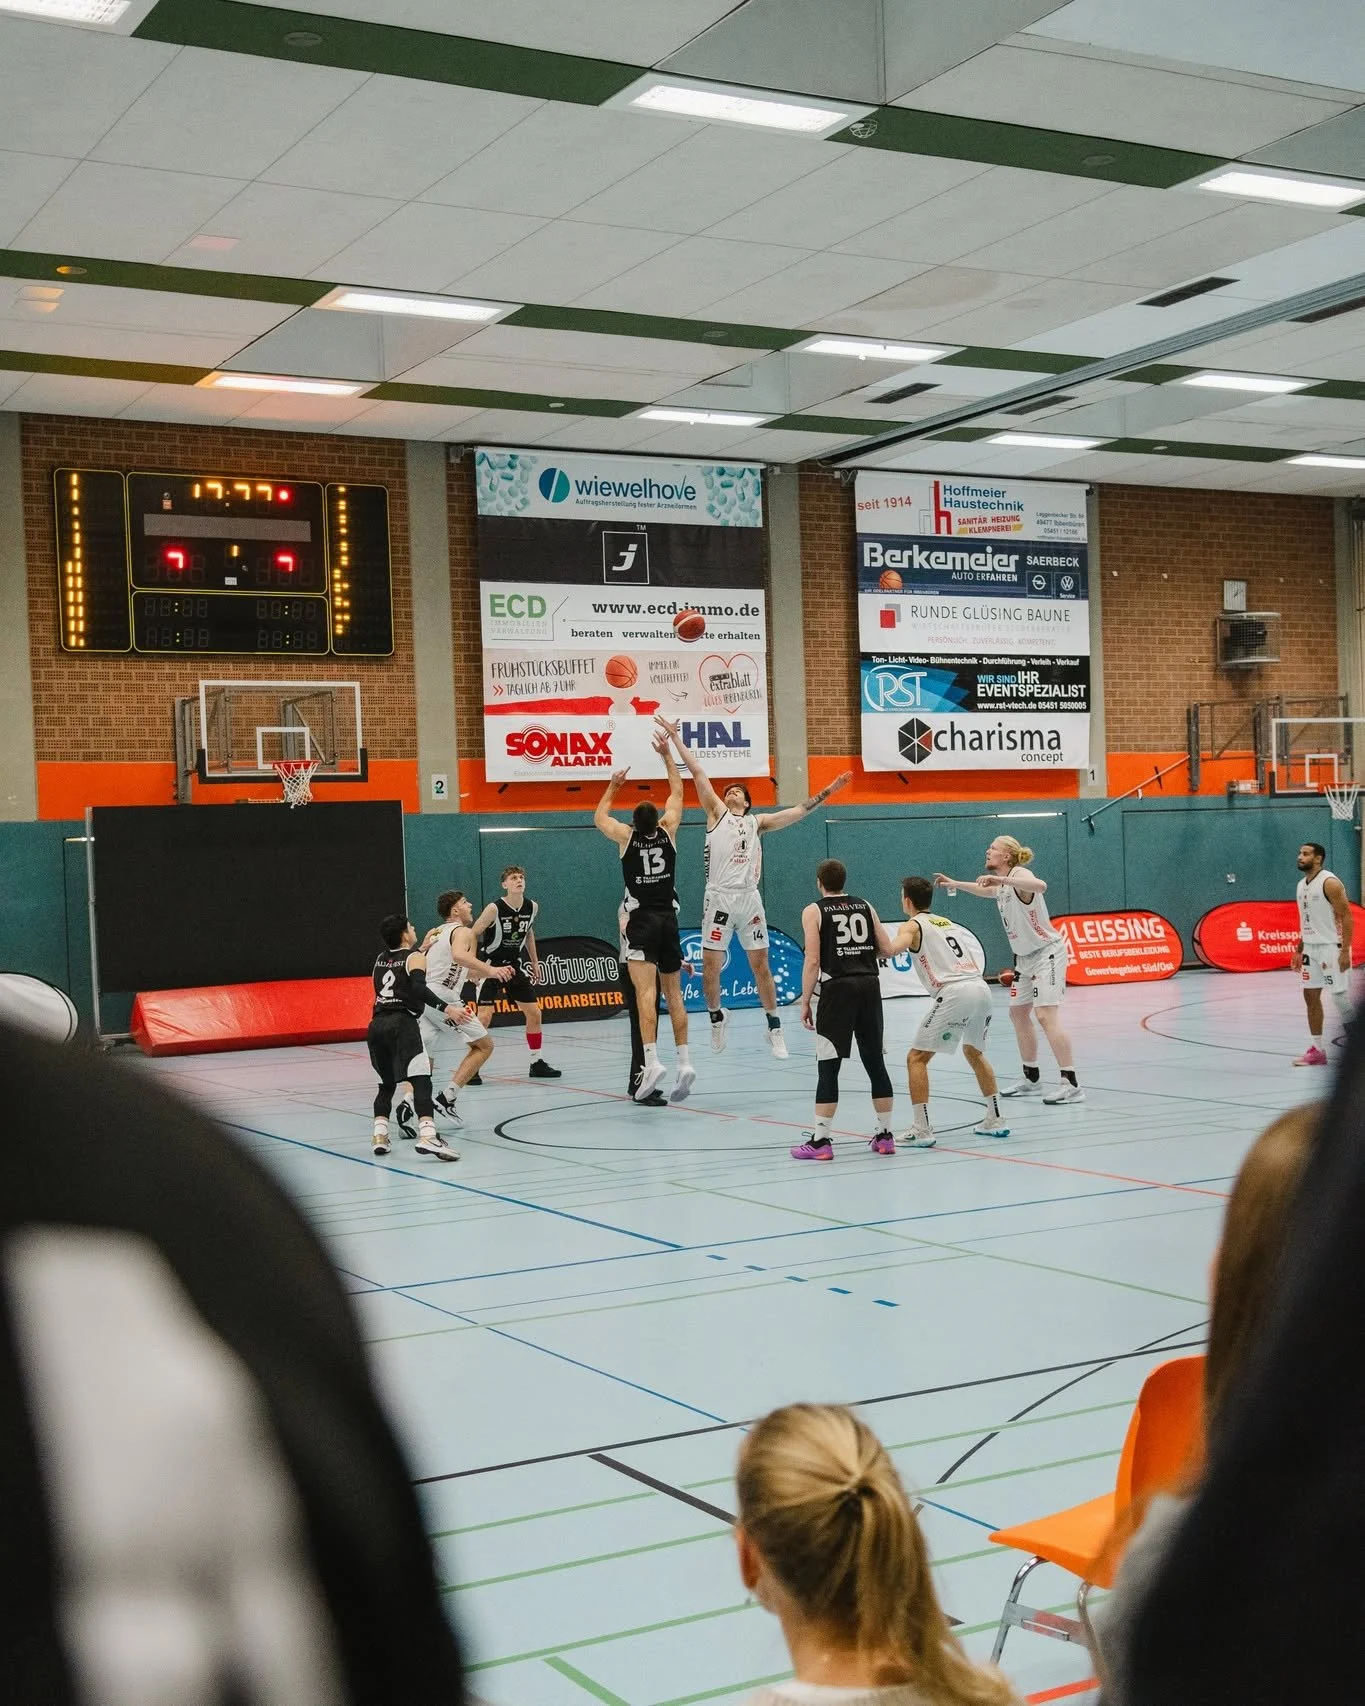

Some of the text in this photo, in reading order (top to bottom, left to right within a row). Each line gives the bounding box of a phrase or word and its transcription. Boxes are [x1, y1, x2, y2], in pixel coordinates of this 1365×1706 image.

[575, 475, 696, 501] wiewelhove
[943, 485, 1006, 499] Hoffmeier
[857, 496, 912, 510] seit 1914
[943, 497, 1024, 511] Haustechnik
[991, 514, 1021, 524] HEIZUNG
[968, 525, 1011, 534] KLEMPNEREI
[863, 541, 1019, 572] Berkemeier
[1026, 555, 1080, 567] SAERBECK
[951, 571, 1018, 582] AUTO ERFAHREN
[489, 594, 547, 619] ECD
[592, 601, 760, 617] www.ecd-immo.de
[911, 604, 1071, 622] RUNDE GLÜSING BAUNE
[571, 628, 613, 638] beraten
[622, 629, 676, 639] verwalten
[717, 631, 761, 641] erhalten
[709, 672, 751, 691] extrablatt
[977, 670, 1040, 684] WIR SIND IHR
[876, 671, 927, 707] RST
[977, 684, 1086, 698] EVENTSPEZIALIST
[977, 701, 1037, 710] www.rst-vtech.de
[933, 721, 1062, 751] charisma
[505, 731, 612, 756] SONAX
[550, 755, 612, 767] ALARM
[690, 749, 752, 759] ELDESYSTEME
[1021, 752, 1064, 764] concept
[1089, 769, 1095, 781] 1
[434, 780, 445, 794] 2
[639, 847, 666, 876] 13
[518, 920, 529, 933] 21
[832, 912, 868, 945] 30
[1070, 917, 1166, 944] LEISSING
[753, 929, 764, 941] 14
[946, 936, 963, 959] 9
[1079, 946, 1170, 960] BESTE BERUFSBEKLEIDUNG
[1085, 961, 1175, 977] Gewerbegebiet Süd/Ost
[379, 969, 396, 998] 2
[732, 980, 759, 997] Lebe
[1033, 988, 1039, 997] 8
[536, 991, 624, 1010] VORARBEITER
